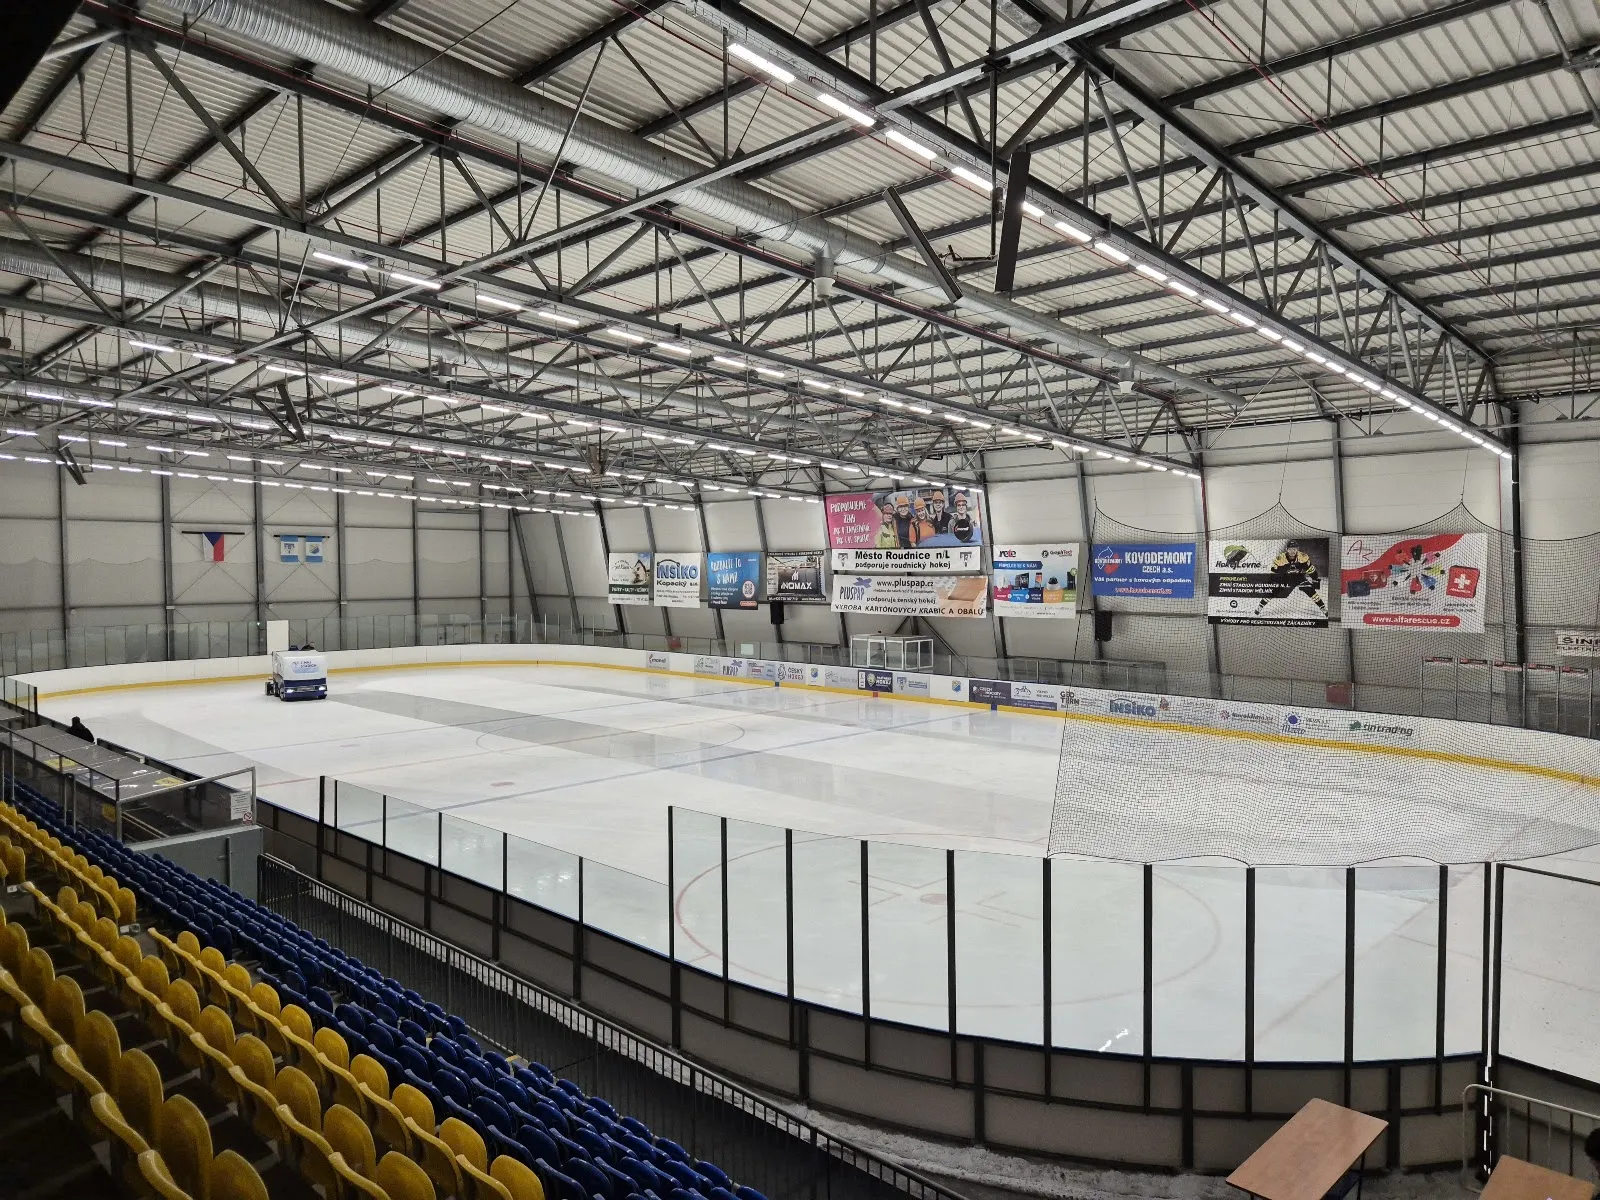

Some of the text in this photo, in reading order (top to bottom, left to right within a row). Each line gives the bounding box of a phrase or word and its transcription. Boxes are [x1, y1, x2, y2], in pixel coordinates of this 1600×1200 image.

[855, 550, 950, 560] Město Roudnice n/L
[1124, 551, 1192, 565] KOVODEMONT
[891, 561, 926, 569] roudnický
[929, 561, 951, 569] hokej
[1142, 565, 1161, 573] CZECH
[876, 578, 934, 588] www.pluspap.cz
[840, 586, 865, 601] PLUSPAP
[918, 607, 945, 615] KRABIC
[957, 607, 985, 616] OBALŮ
